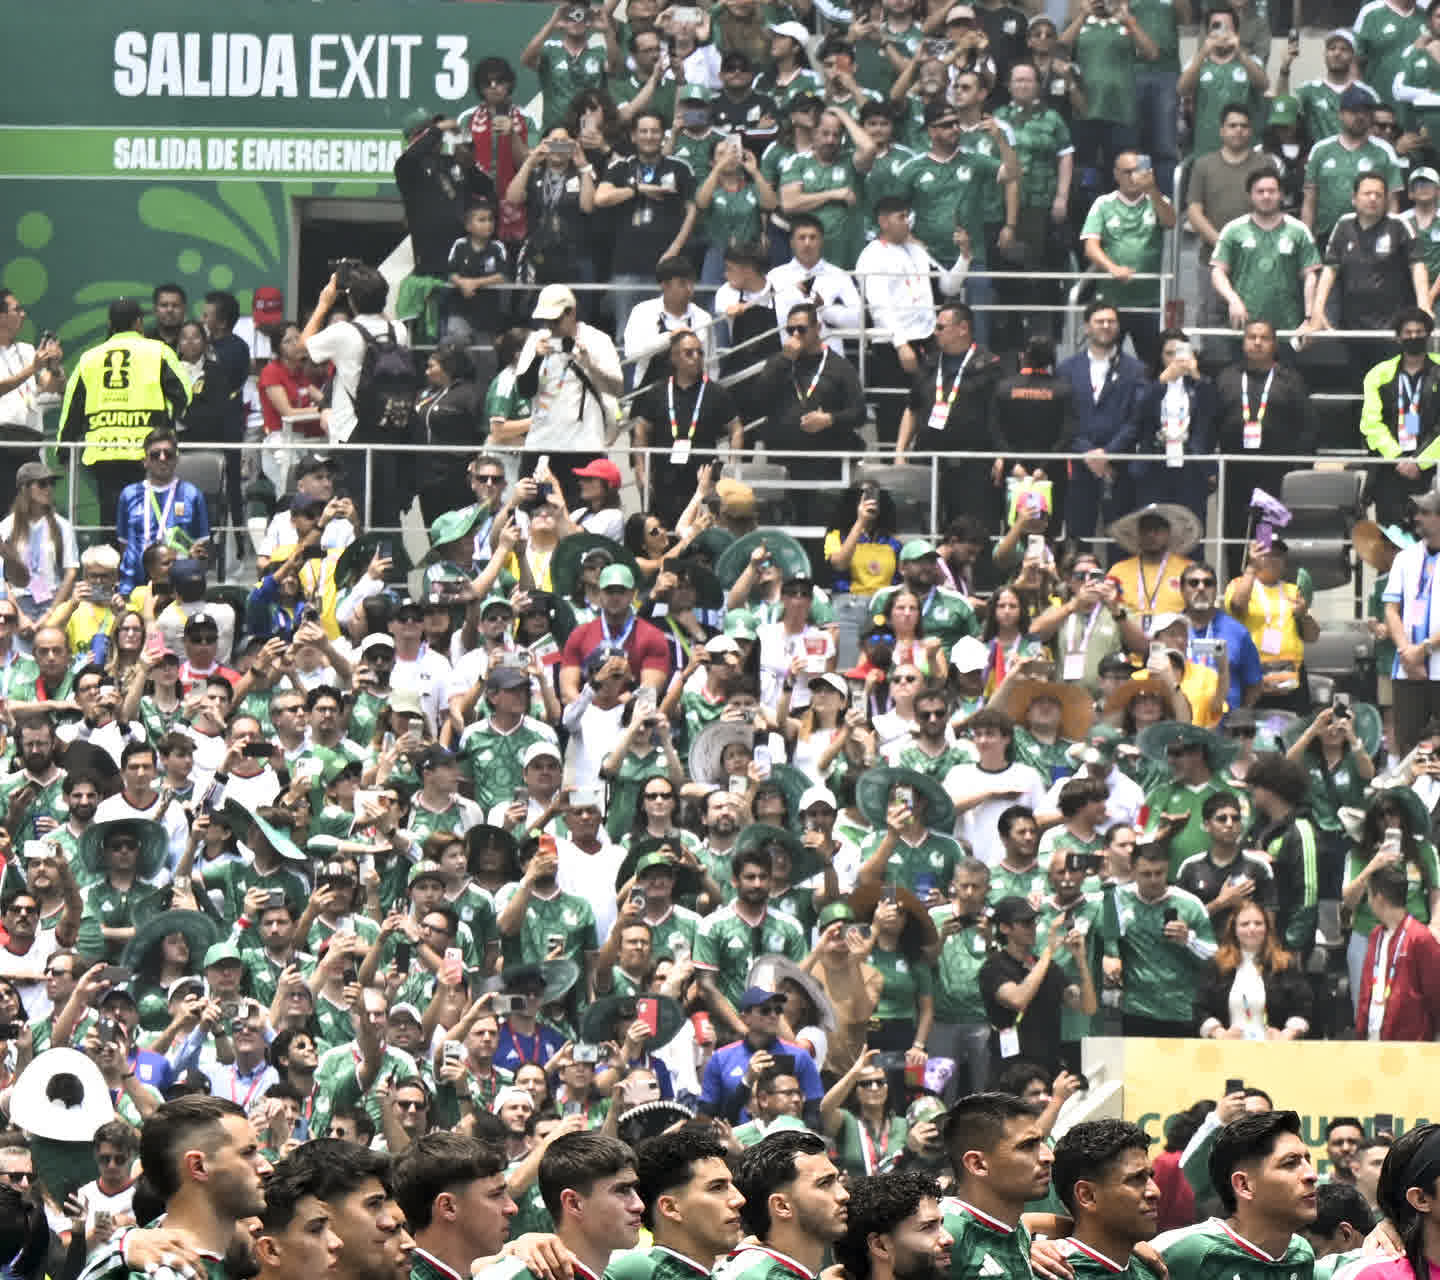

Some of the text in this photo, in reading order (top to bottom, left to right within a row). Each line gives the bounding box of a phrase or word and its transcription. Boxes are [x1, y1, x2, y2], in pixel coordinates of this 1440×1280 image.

[113, 30, 470, 100] SALIDA EXIT 3
[113, 136, 200, 170] SALIDA
[206, 138, 239, 171] DE
